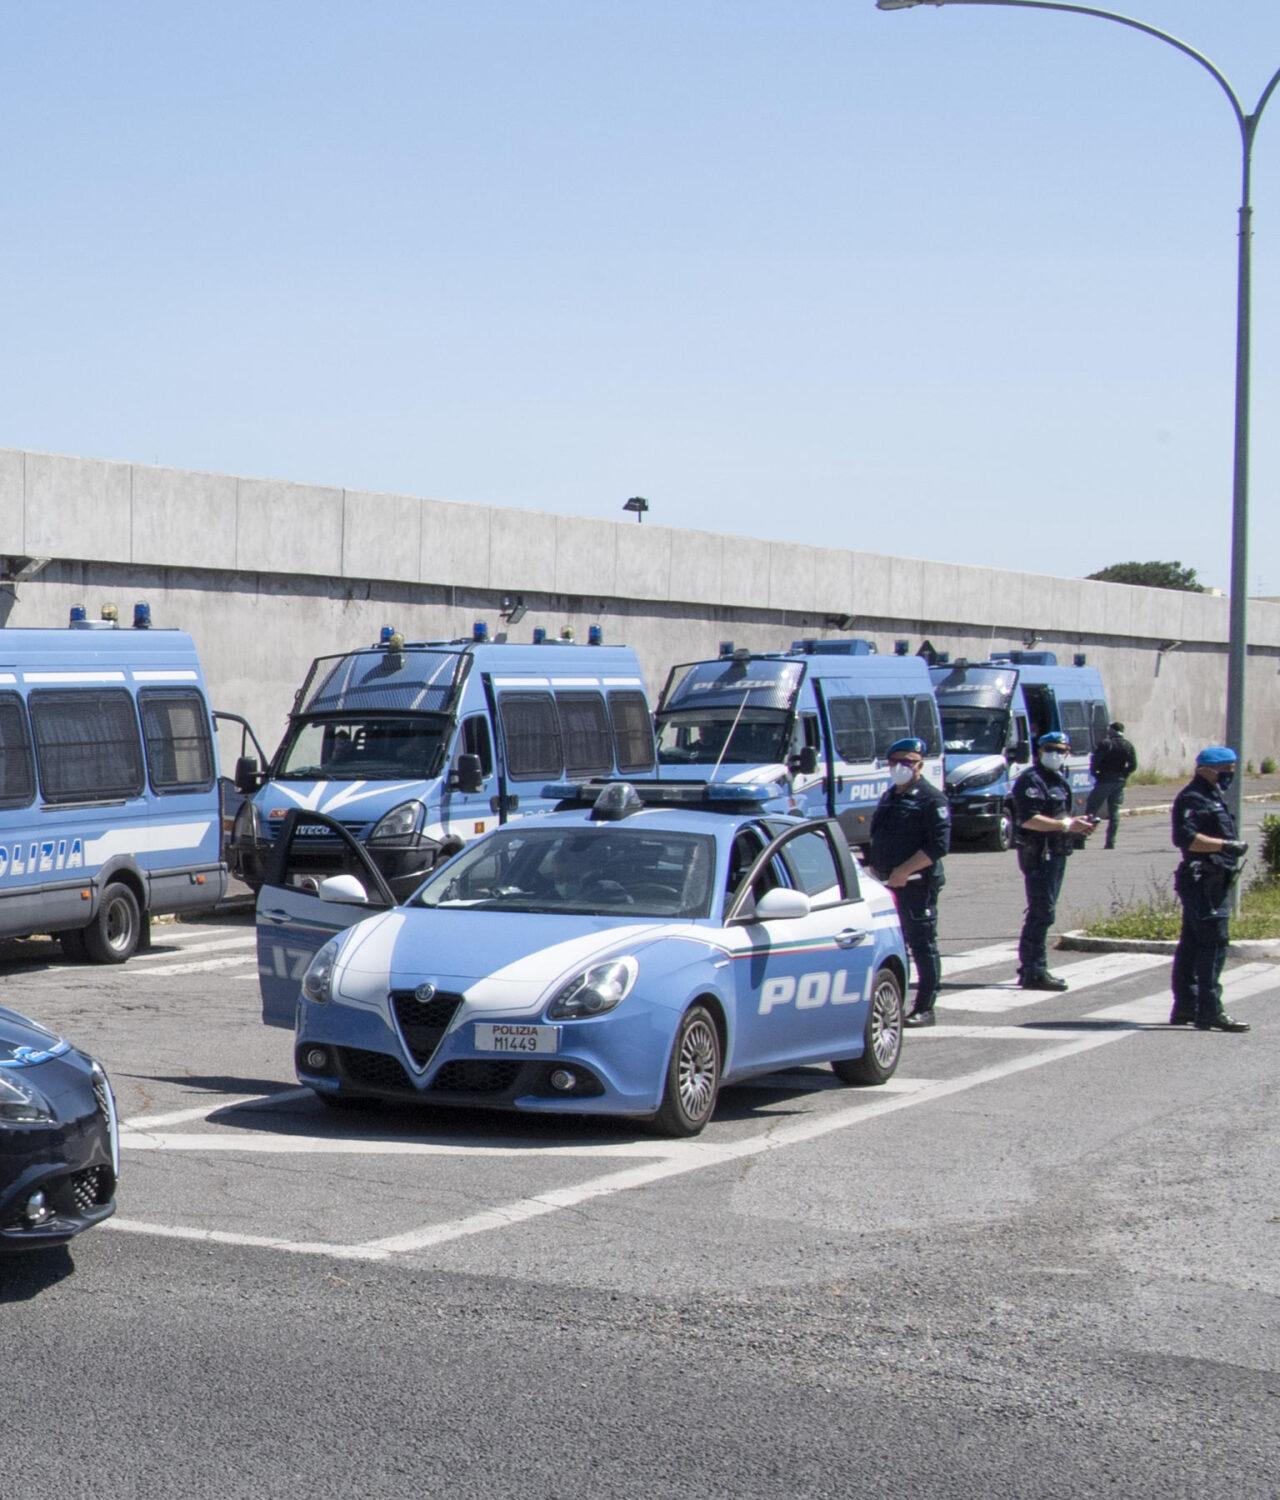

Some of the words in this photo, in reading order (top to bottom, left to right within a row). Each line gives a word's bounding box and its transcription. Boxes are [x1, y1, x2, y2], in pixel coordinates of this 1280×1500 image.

[295, 825, 330, 835] IVECO
[493, 1025, 538, 1035] POLIZIA
[494, 1037, 537, 1051] M1449
